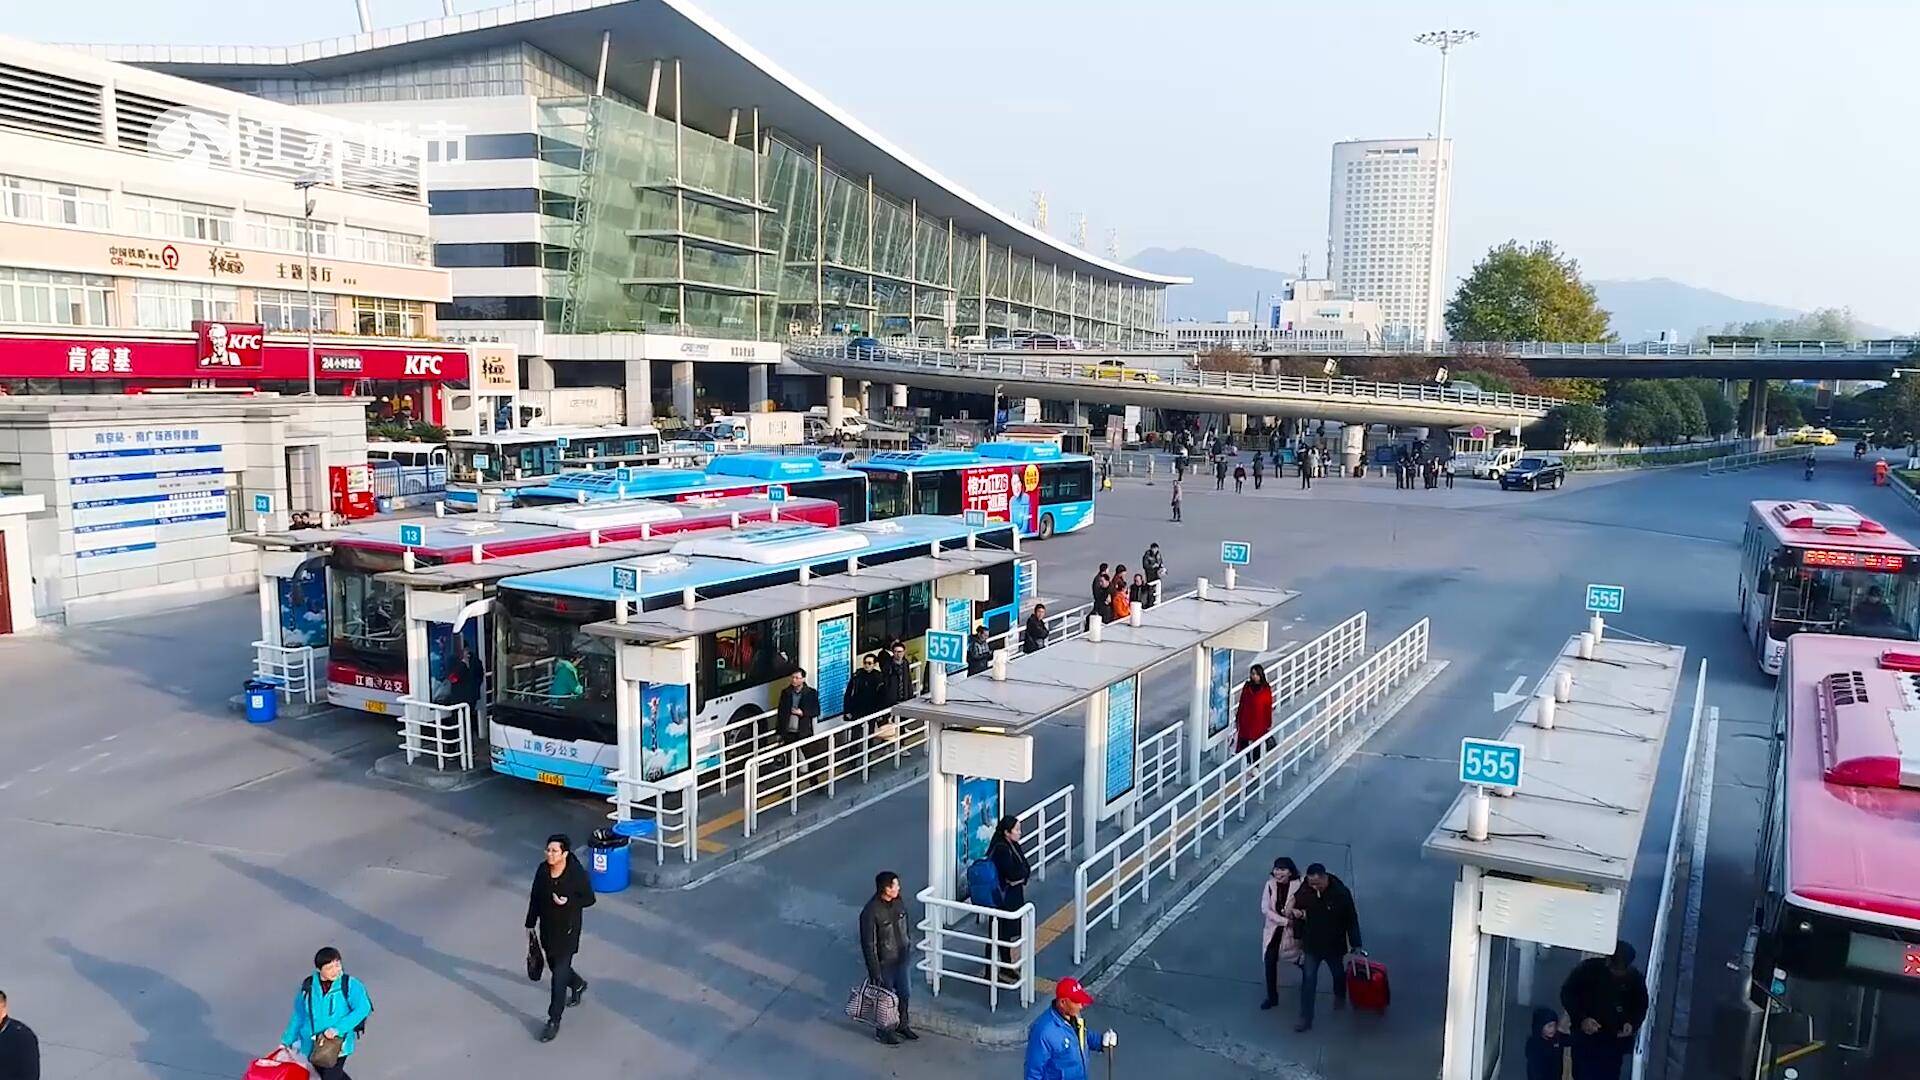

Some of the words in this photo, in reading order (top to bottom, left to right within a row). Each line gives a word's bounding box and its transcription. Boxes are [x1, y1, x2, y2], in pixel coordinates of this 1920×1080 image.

[228, 333, 262, 350] KFC
[67, 345, 133, 373] 肯德基
[404, 355, 444, 375] KFC
[406, 530, 417, 541] 13
[1224, 544, 1246, 560] 557
[1590, 589, 1619, 608] 555
[930, 635, 960, 659] 557
[355, 674, 374, 688] 江南
[383, 680, 403, 692] 公交
[523, 739, 542, 752] 江南
[559, 744, 578, 758] 公交
[1466, 748, 1515, 779] 555
